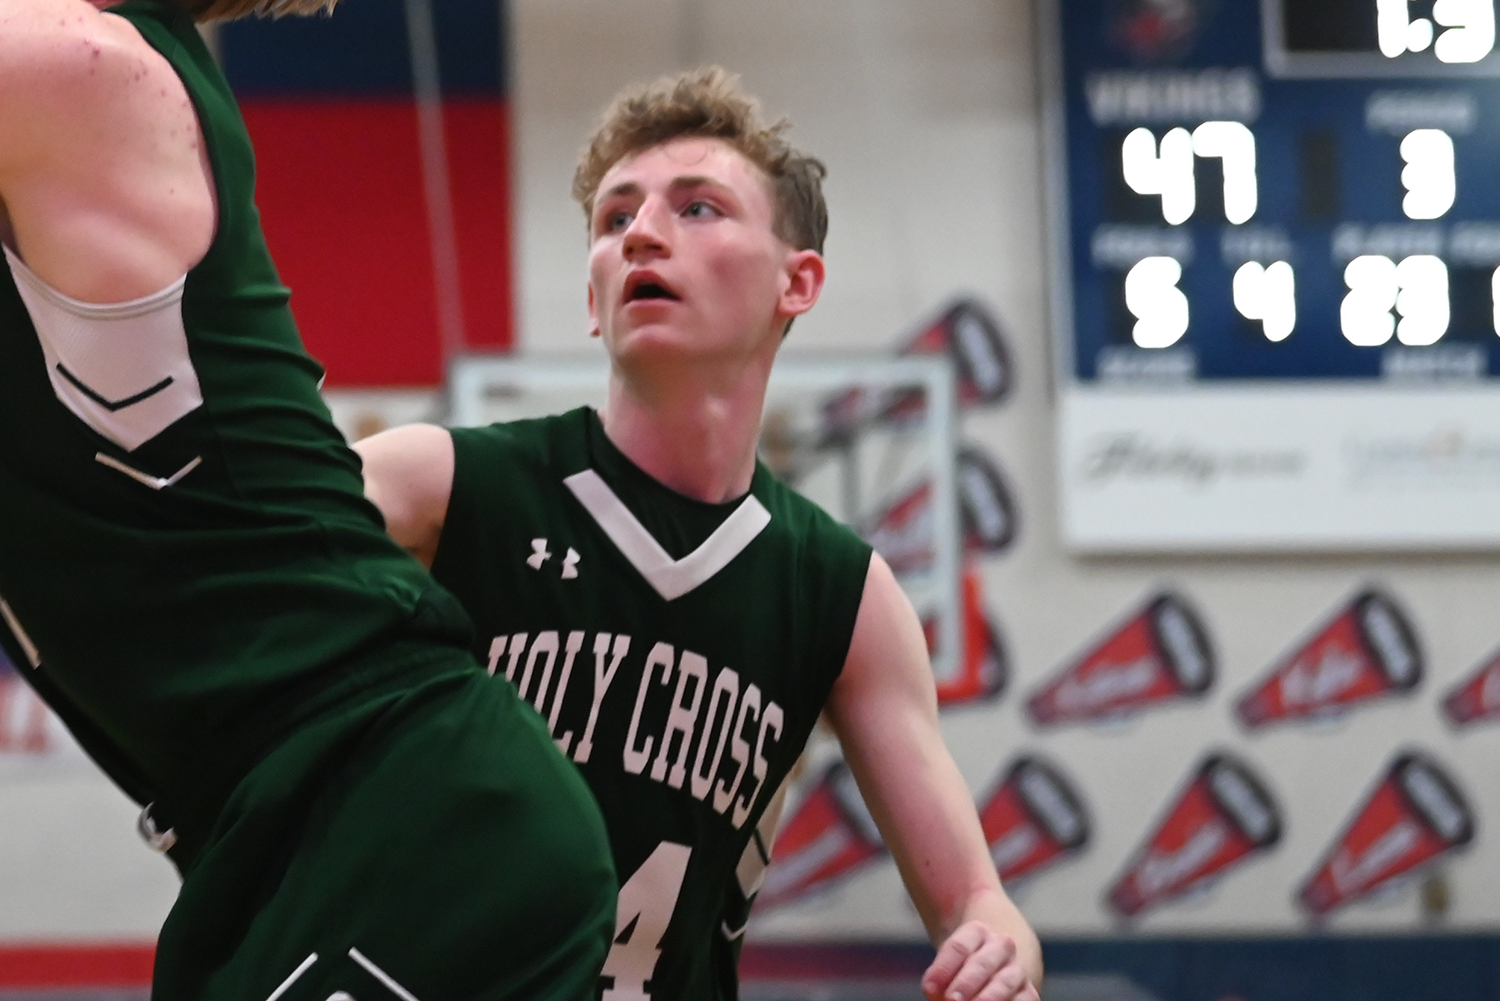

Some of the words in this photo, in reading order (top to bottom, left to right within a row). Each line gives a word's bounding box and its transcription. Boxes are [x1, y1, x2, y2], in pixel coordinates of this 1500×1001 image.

[1122, 121, 1258, 225] 47
[1125, 256, 1189, 349] 5
[1233, 260, 1296, 342] 4
[623, 641, 784, 830] CROSS
[599, 840, 692, 1001] 4
